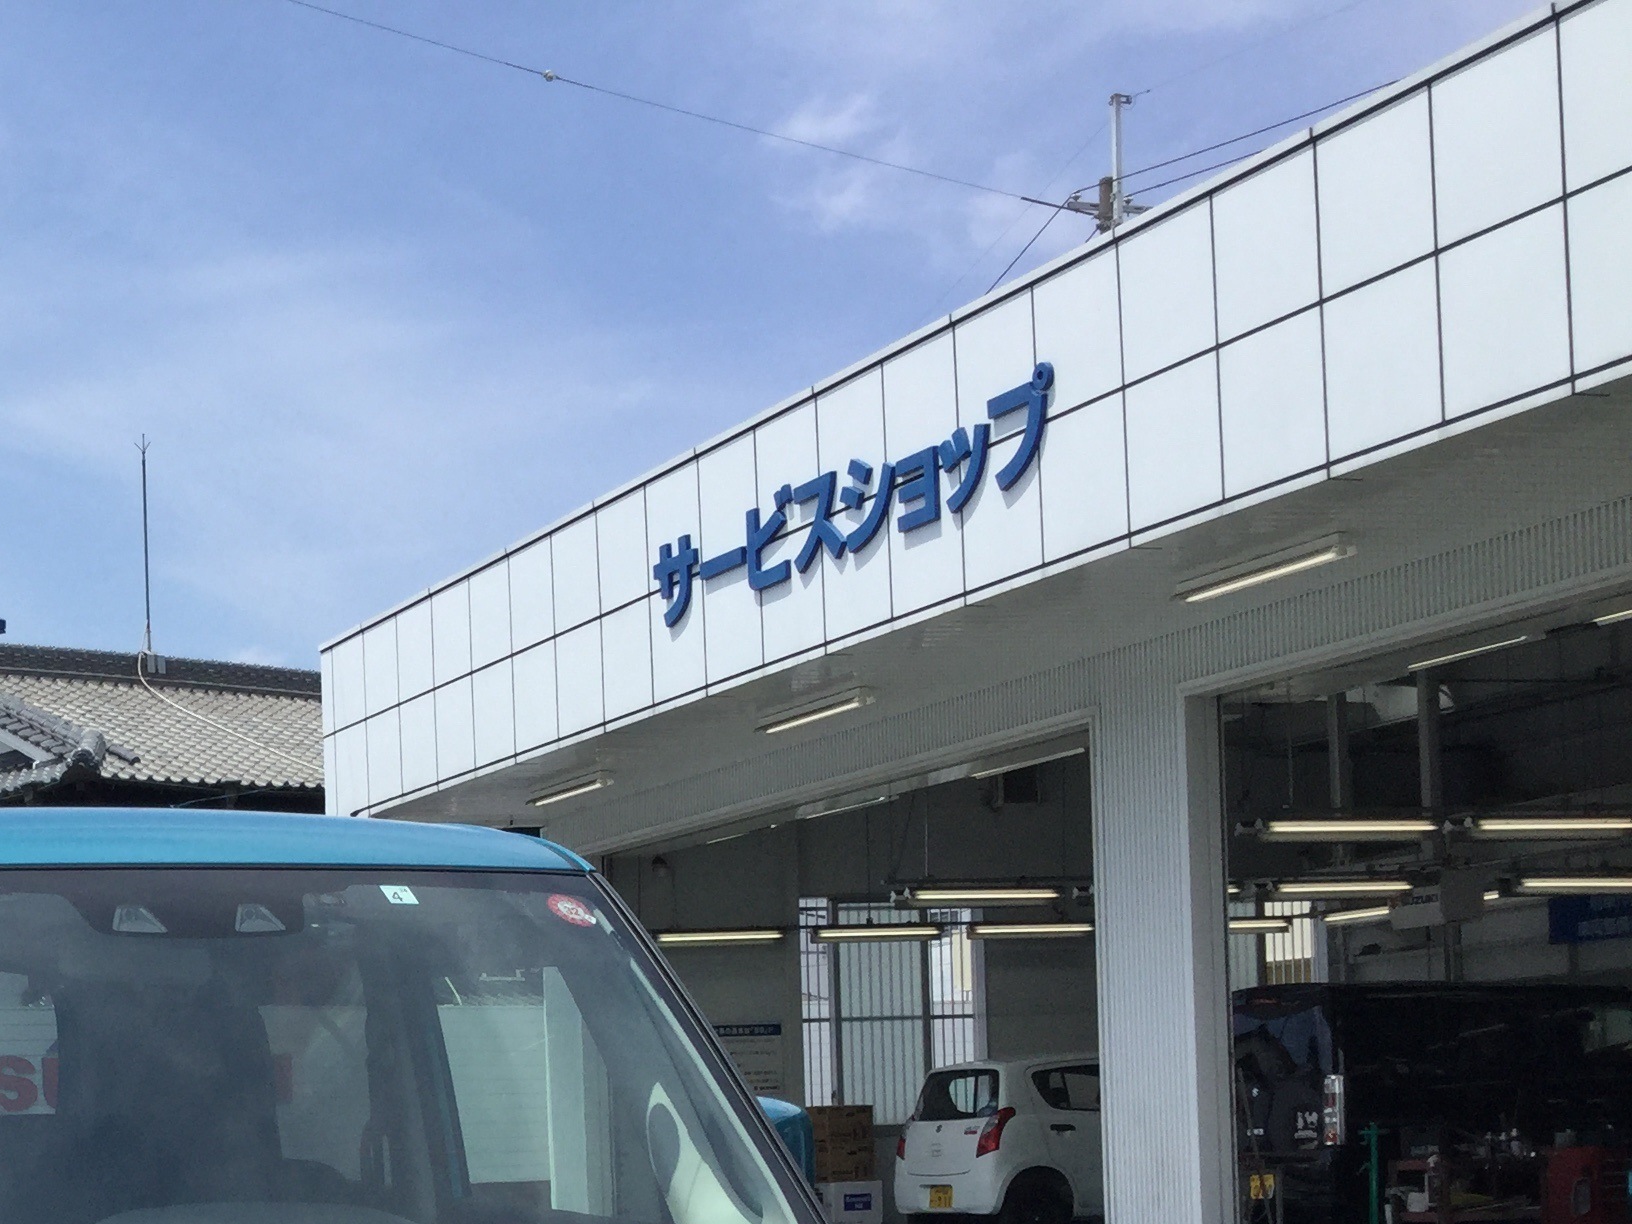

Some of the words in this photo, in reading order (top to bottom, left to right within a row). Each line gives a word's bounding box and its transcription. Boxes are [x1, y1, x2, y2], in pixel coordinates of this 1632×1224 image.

[653, 361, 1055, 628] サービスショップ
